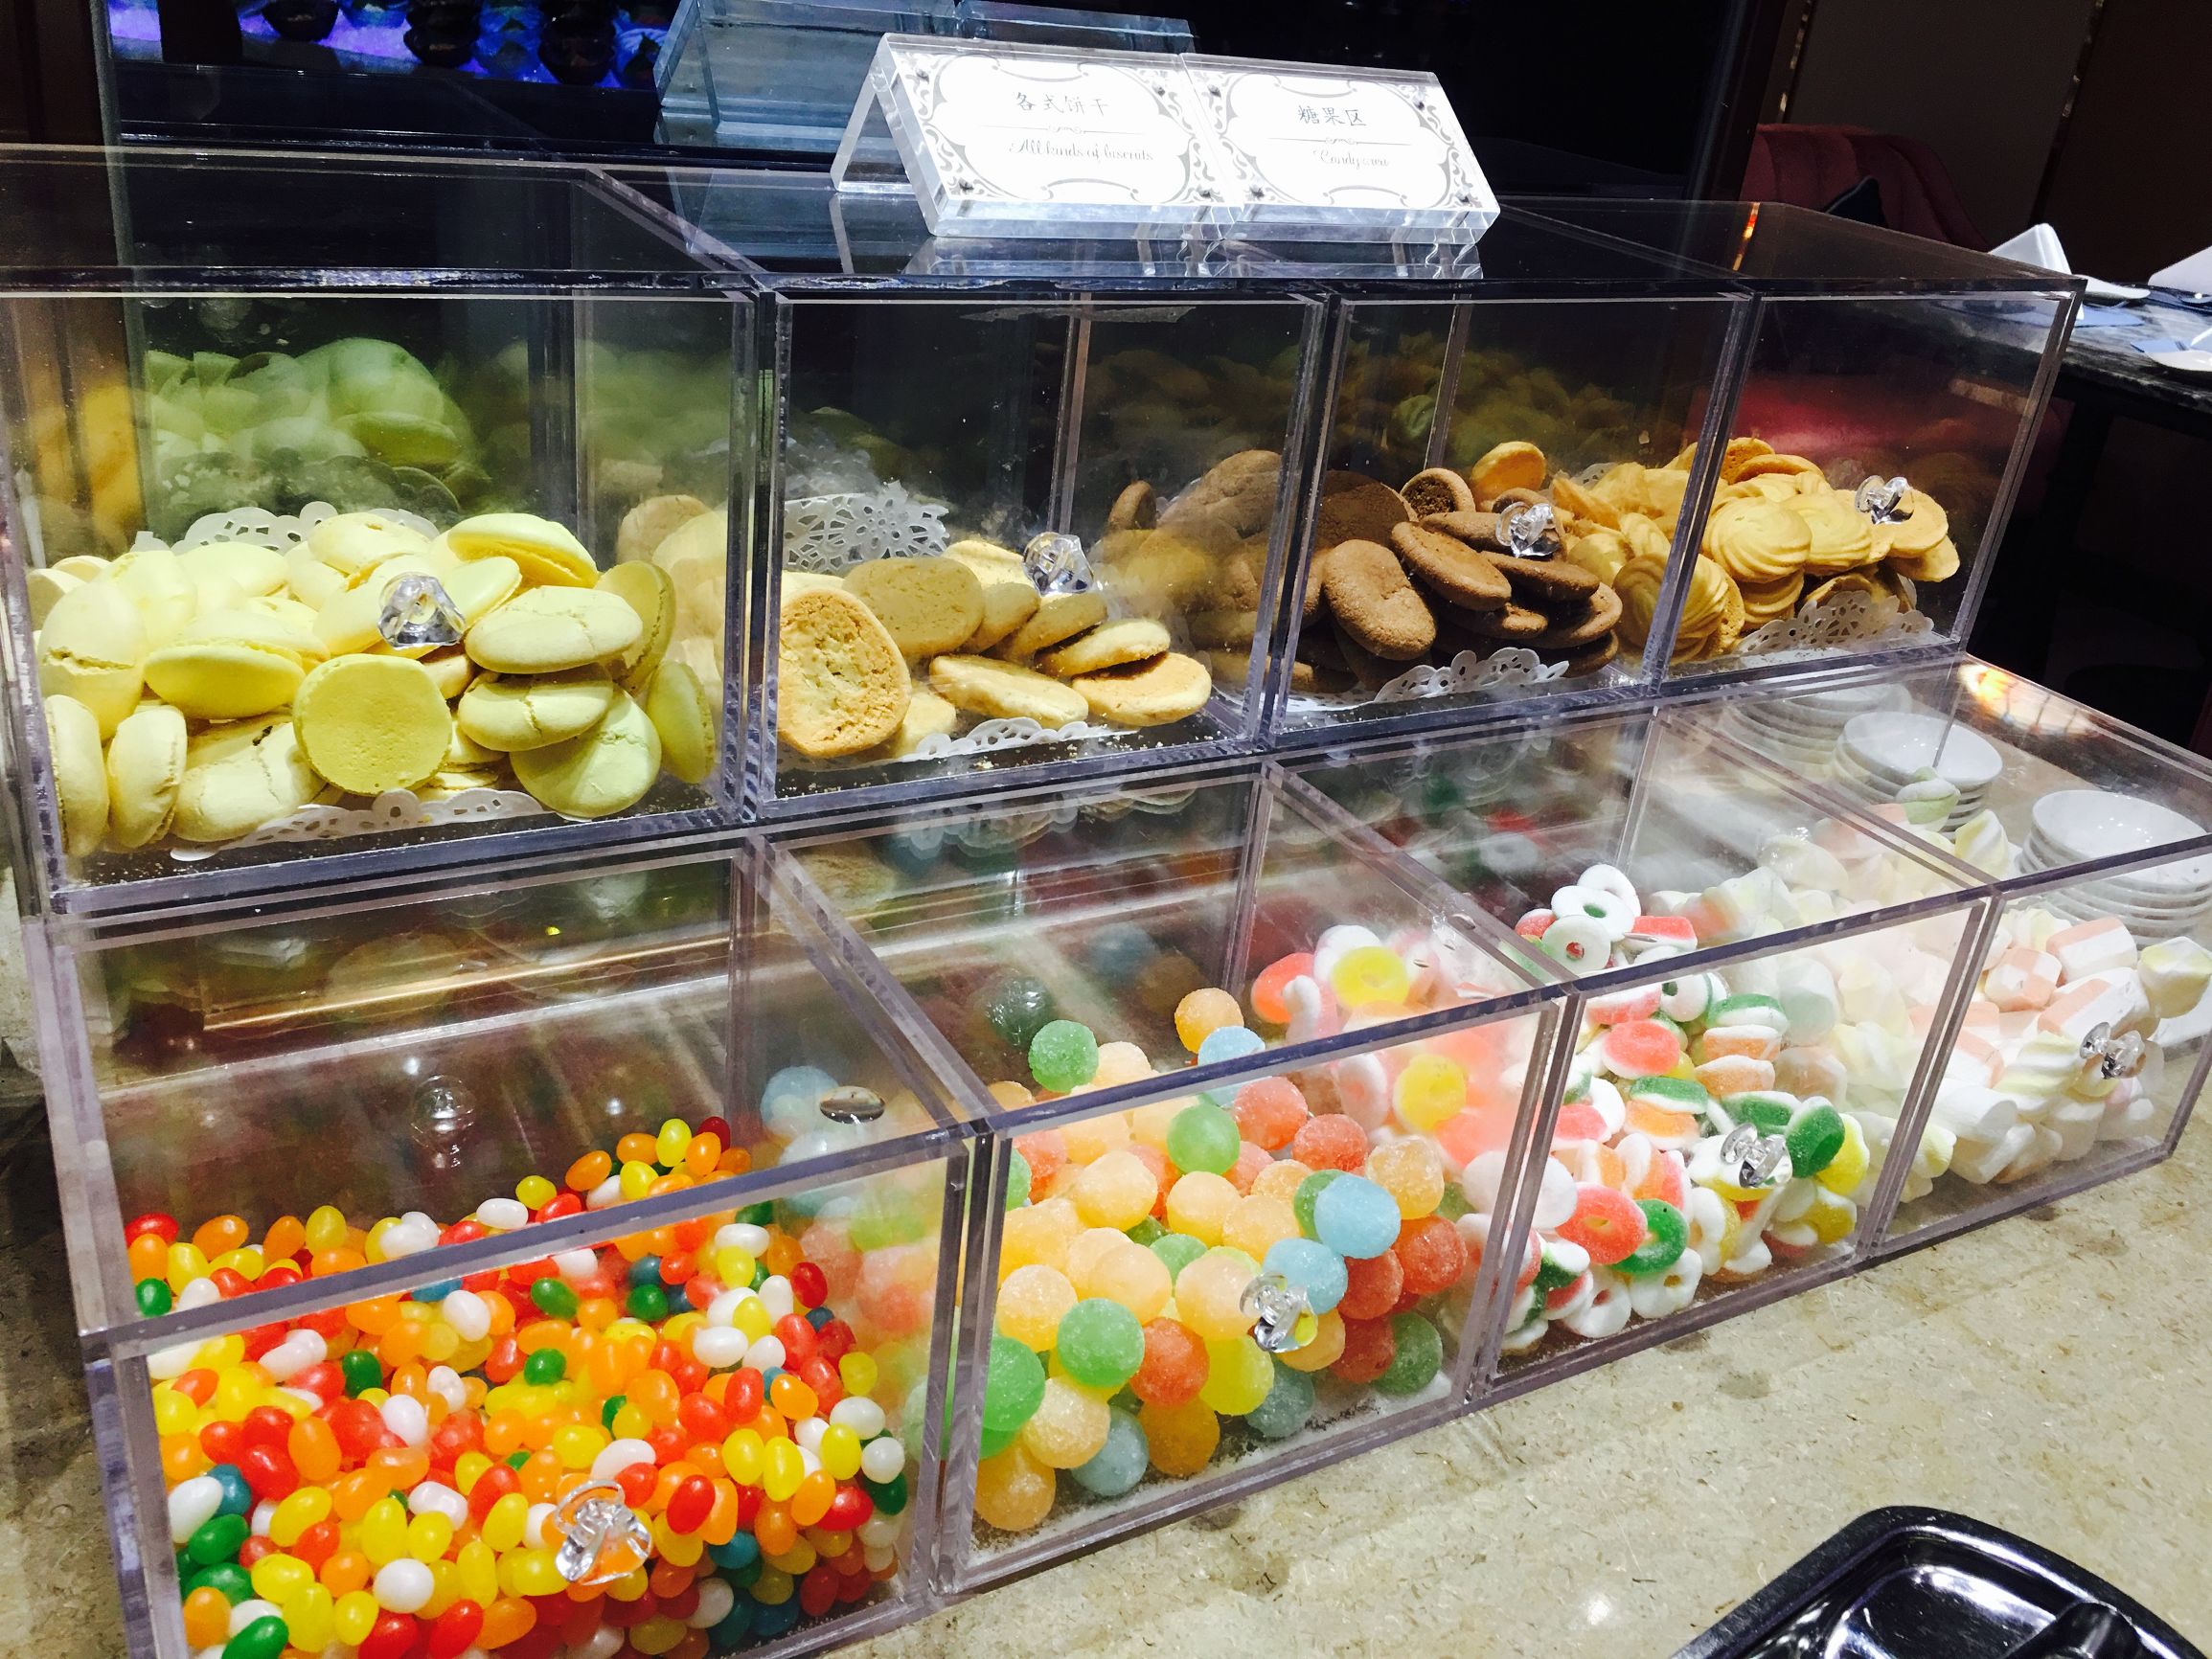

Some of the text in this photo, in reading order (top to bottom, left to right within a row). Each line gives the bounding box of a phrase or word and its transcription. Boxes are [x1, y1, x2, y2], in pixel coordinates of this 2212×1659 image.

[1015, 91, 1109, 116] 各式饼干
[1296, 104, 1367, 126] 糖果区
[1009, 139, 1045, 155] All
[1046, 140, 1083, 157] kinds
[1086, 145, 1102, 168] of
[1312, 149, 1360, 170] Candy
